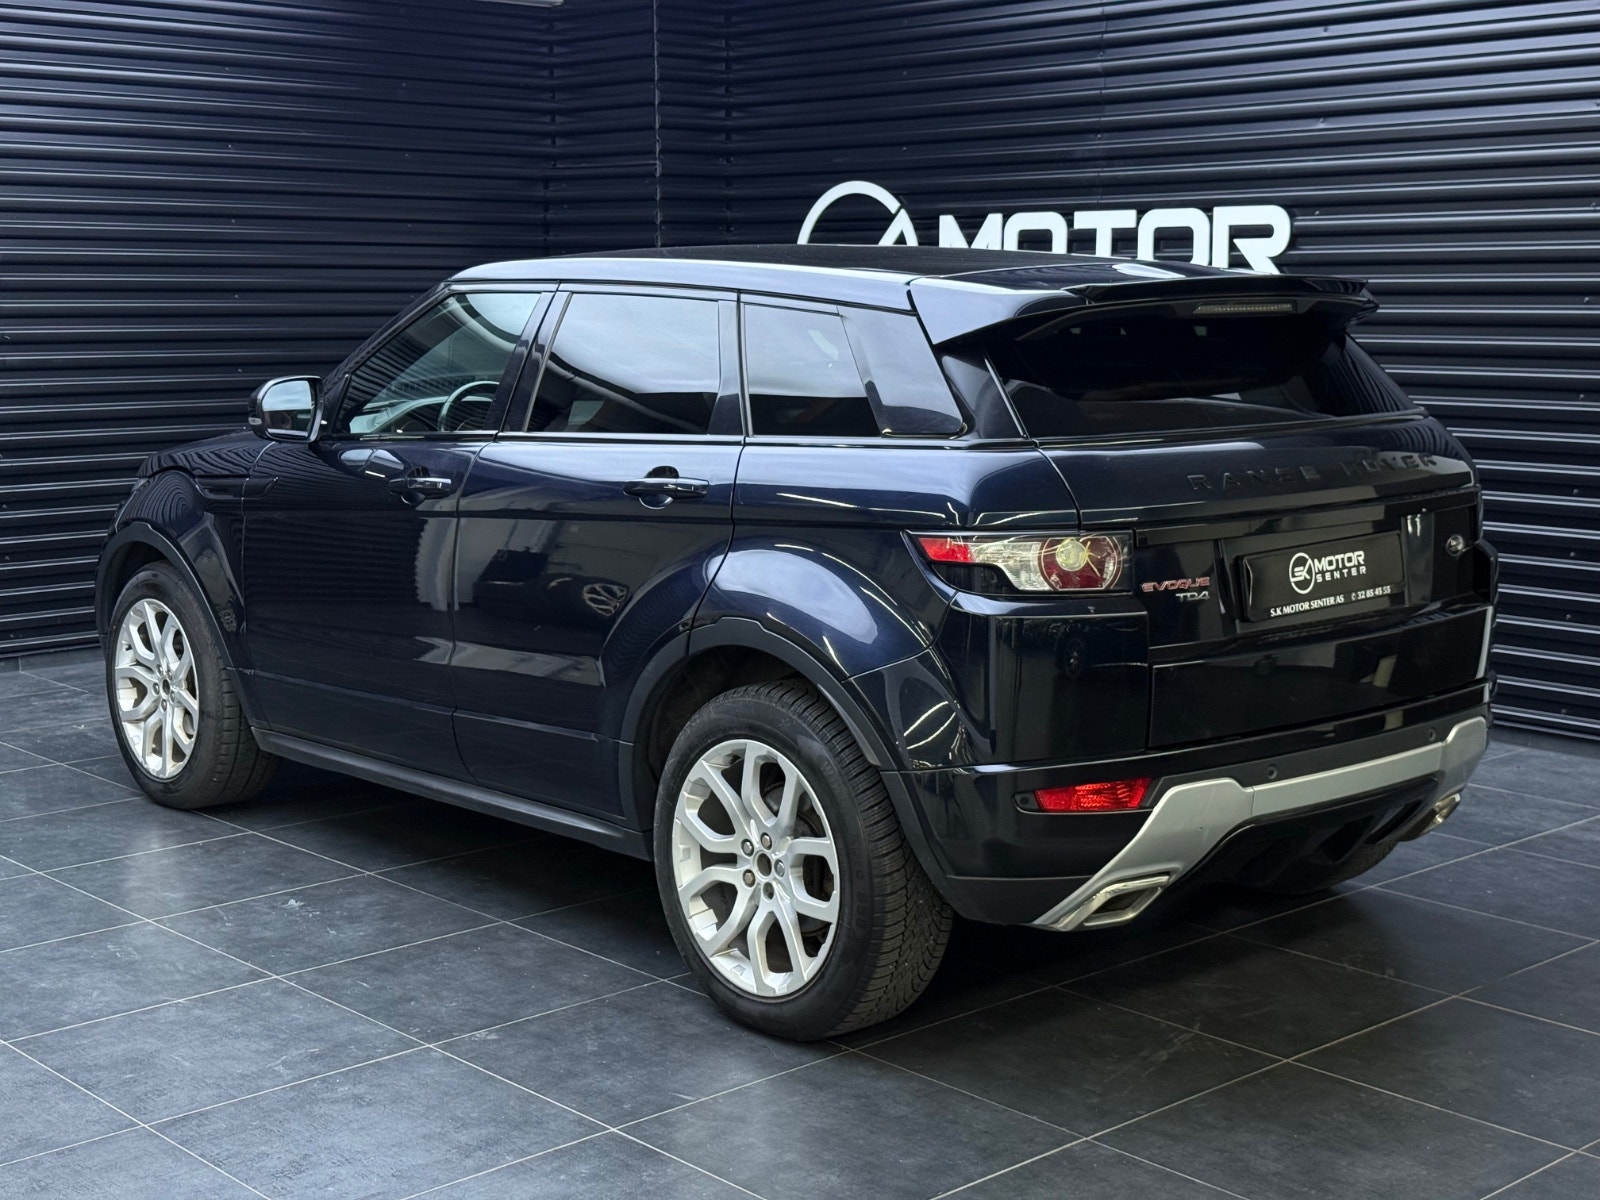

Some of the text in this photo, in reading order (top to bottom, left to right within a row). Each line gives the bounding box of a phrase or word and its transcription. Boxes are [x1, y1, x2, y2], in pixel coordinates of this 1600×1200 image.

[1314, 550, 1365, 573] MOTOR
[1316, 565, 1367, 583] SENTER
[1141, 576, 1210, 593] EVOQUE
[1175, 590, 1210, 602] TD4
[1269, 607, 1282, 617] S.K
[1282, 602, 1310, 614] MOTOR
[1310, 597, 1335, 609] SENTER
[1335, 594, 1344, 605] AS
[1357, 590, 1366, 600] 32
